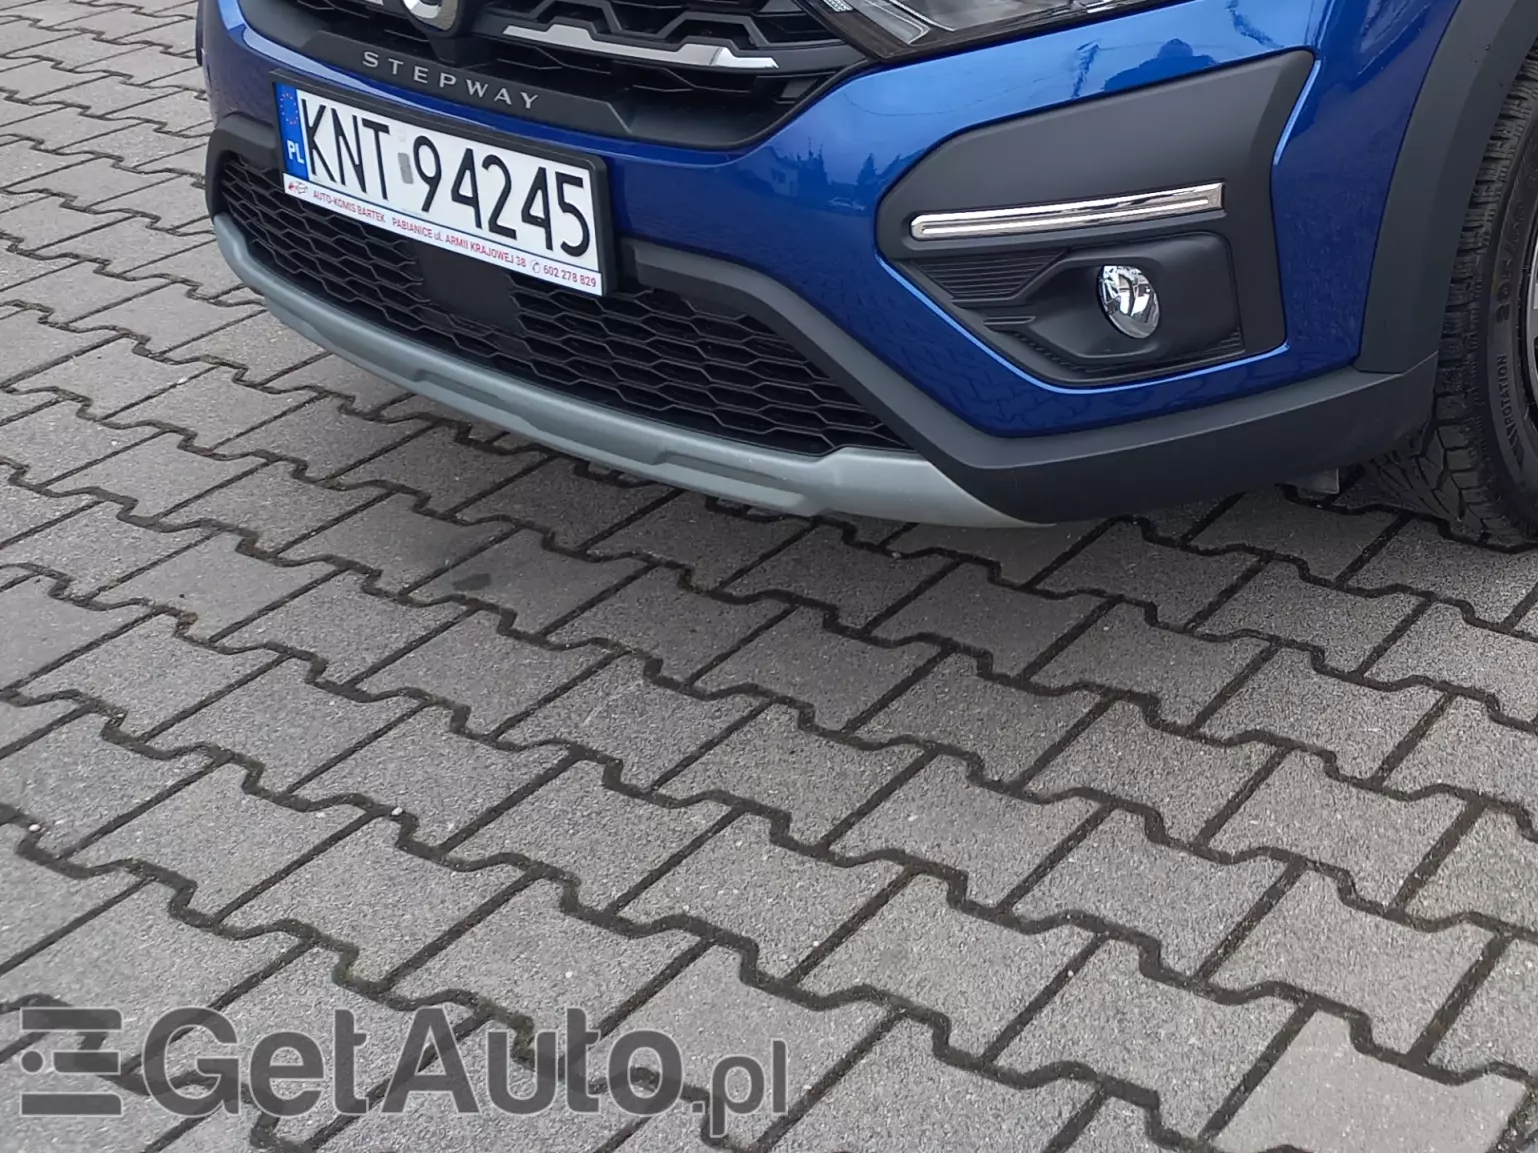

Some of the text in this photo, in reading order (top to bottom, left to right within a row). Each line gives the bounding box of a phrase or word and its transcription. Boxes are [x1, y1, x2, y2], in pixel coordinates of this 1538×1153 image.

[362, 51, 539, 109] STEPWAY
[286, 139, 304, 165] PL
[301, 98, 591, 258] KNT 94245
[313, 190, 356, 212] AUTO-KOMIS
[357, 205, 386, 223] BARTEK
[392, 217, 433, 239] PABIANICE
[445, 235, 469, 250] ARMII
[470, 241, 515, 264] KRAJOWEJ
[515, 255, 527, 268] 38
[543, 264, 560, 278] 602
[561, 268, 578, 283] 278
[580, 274, 597, 288] 829
[1497, 353, 1516, 428] ROTATION
